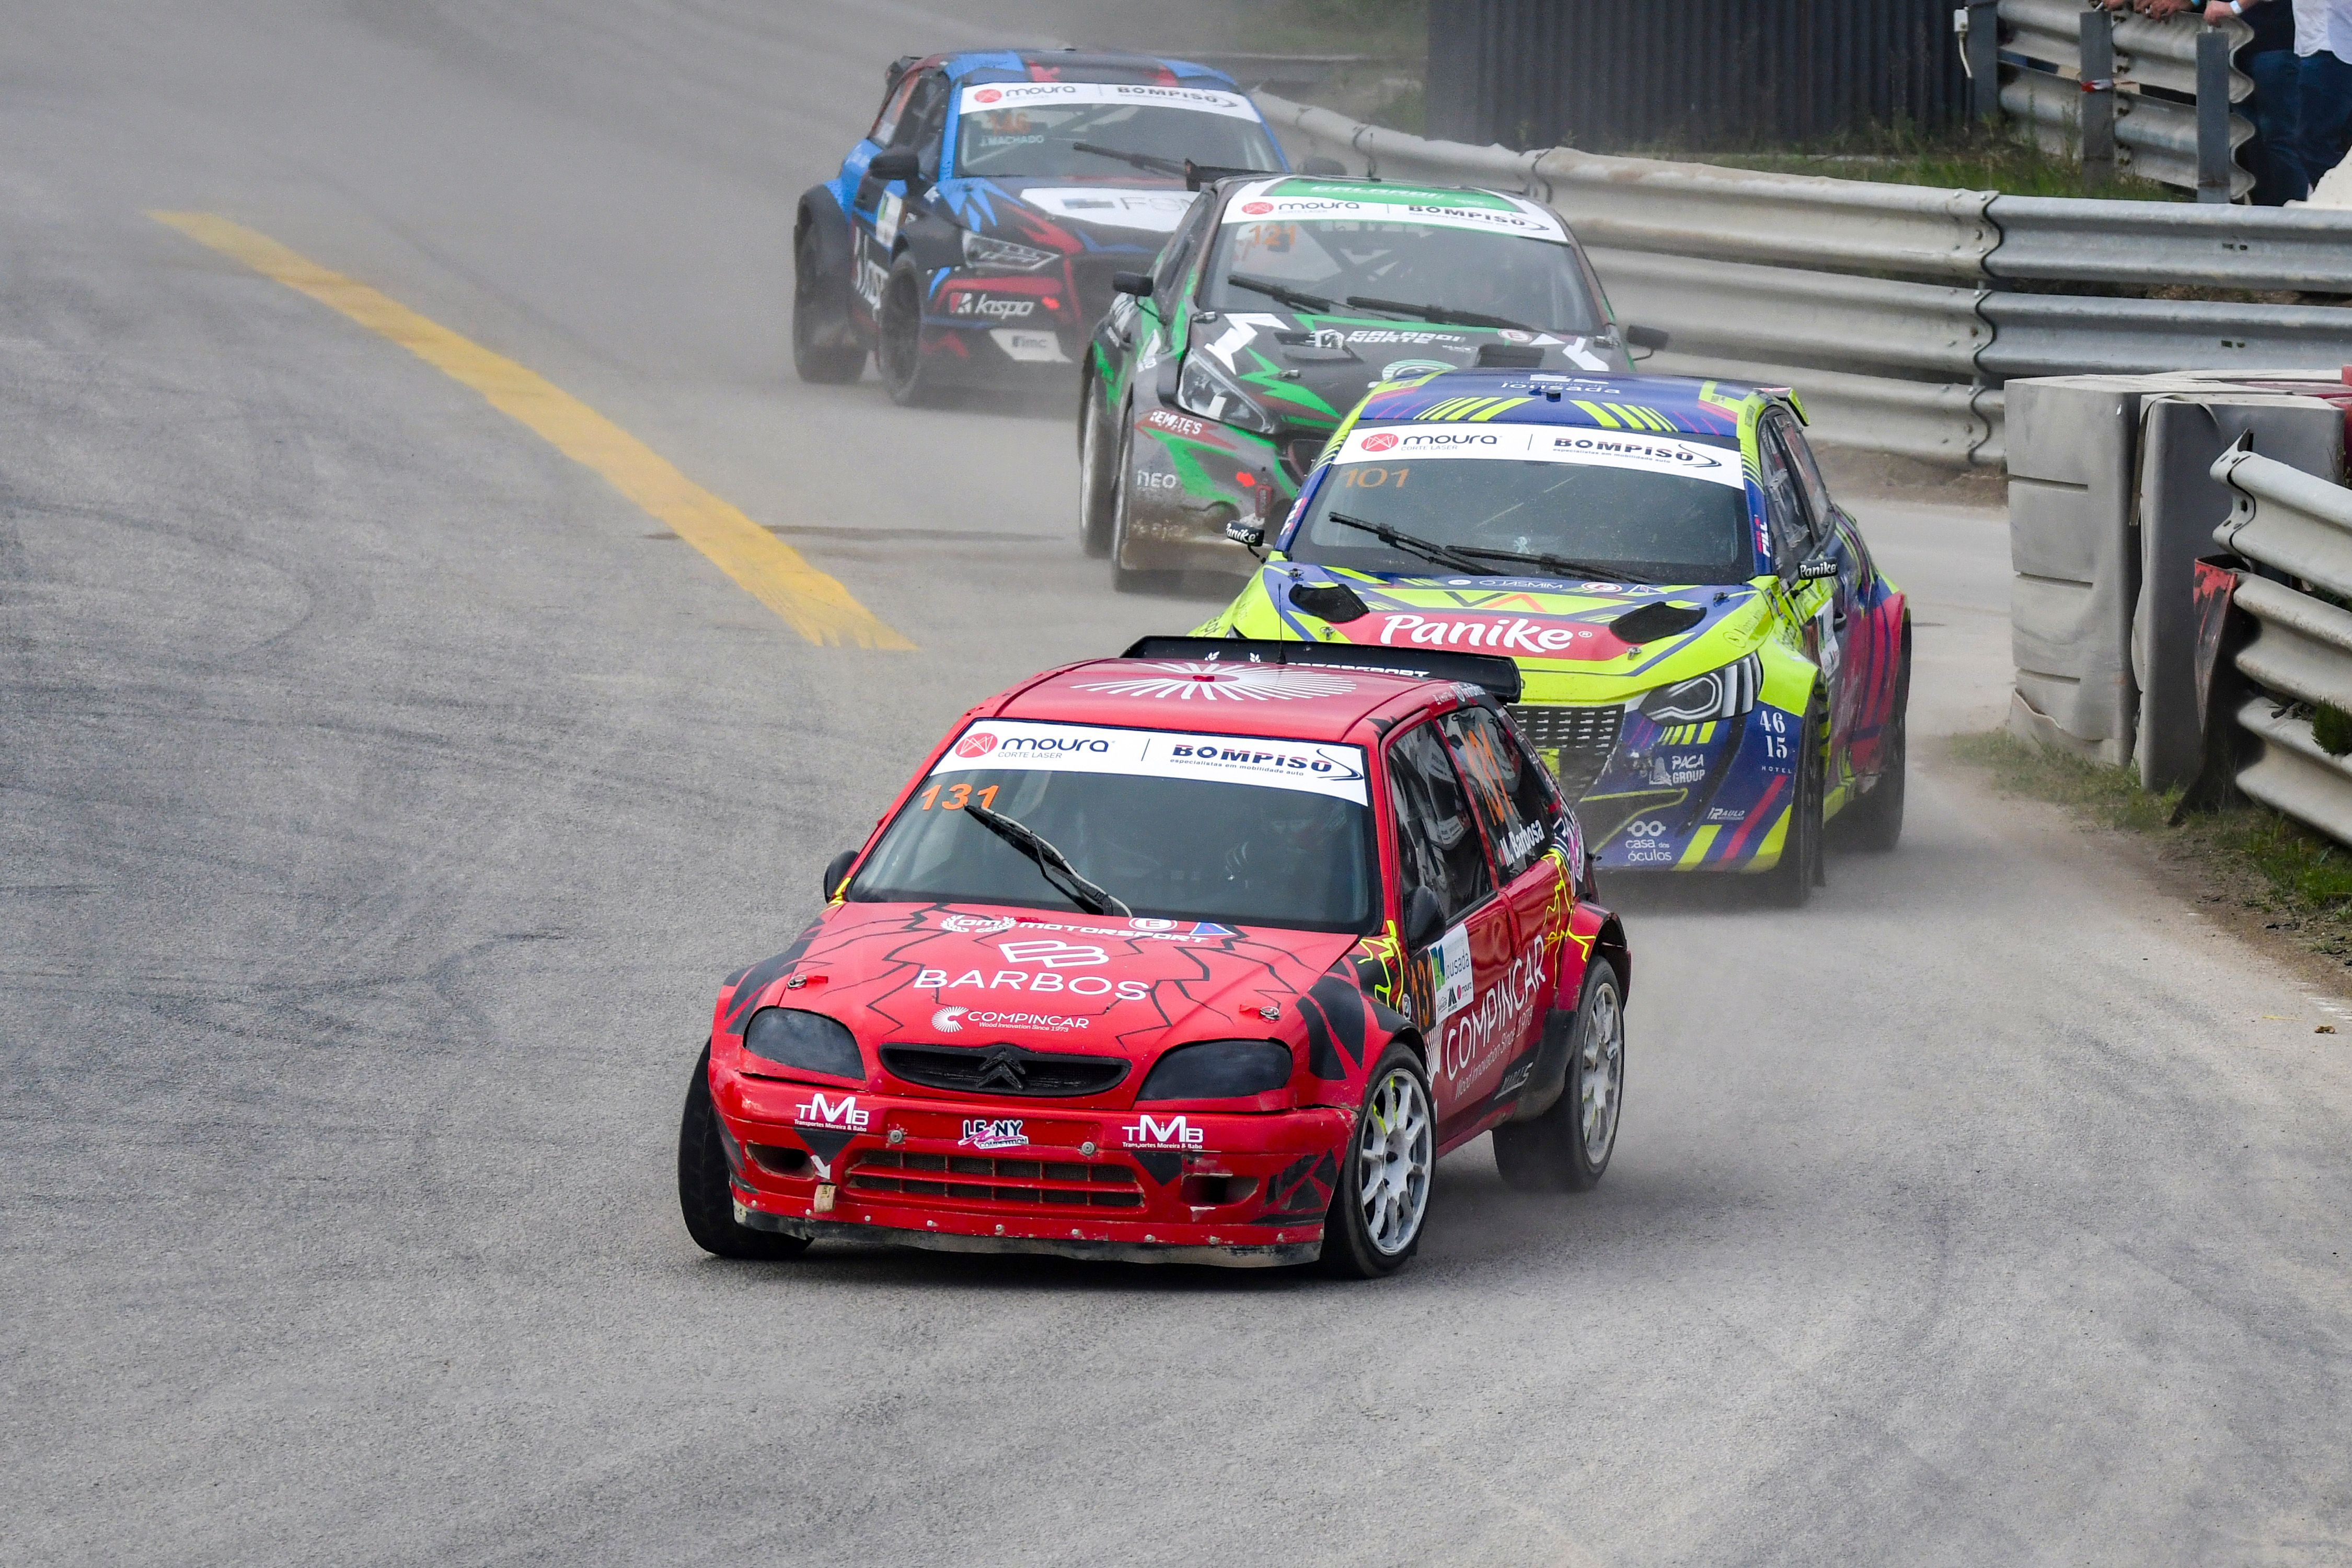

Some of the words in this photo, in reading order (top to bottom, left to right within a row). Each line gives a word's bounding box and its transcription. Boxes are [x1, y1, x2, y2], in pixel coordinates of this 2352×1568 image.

[1006, 86, 1076, 97] moura
[1117, 86, 1218, 102] BOMPISO
[1409, 204, 1525, 226] BOMPISO
[1249, 225, 1296, 246] 121
[1403, 435, 1497, 444] moura
[1554, 438, 1693, 461] BOMPISO
[1341, 468, 1410, 489] 101
[1799, 561, 1837, 578] Panike
[1380, 614, 1574, 653] Panike
[1760, 710, 1785, 733] 46
[1001, 737, 1109, 753] moura
[1766, 735, 1788, 758] 15
[1170, 758, 1222, 767] especialistas
[1240, 765, 1284, 774] mobilidade
[1172, 744, 1332, 772] BOMPISO
[1671, 754, 1704, 770] PACA
[1673, 769, 1706, 784] GROUP
[1761, 765, 1792, 774] HOTEL
[920, 783, 999, 810] 131
[1508, 820, 1545, 859] Barbosa
[1625, 839, 1655, 848] casa
[1628, 849, 1672, 861] óculos
[1019, 921, 1210, 943] MOTORSPORT
[1446, 949, 1470, 981] ousada
[913, 969, 1149, 1000] BARBOS
[1447, 935, 1546, 1081] COMPINCAR
[967, 1011, 1089, 1029] COMPINCAR
[795, 1093, 870, 1126] TMB
[794, 1119, 824, 1127] Transportes
[1122, 1114, 1203, 1143] TMB
